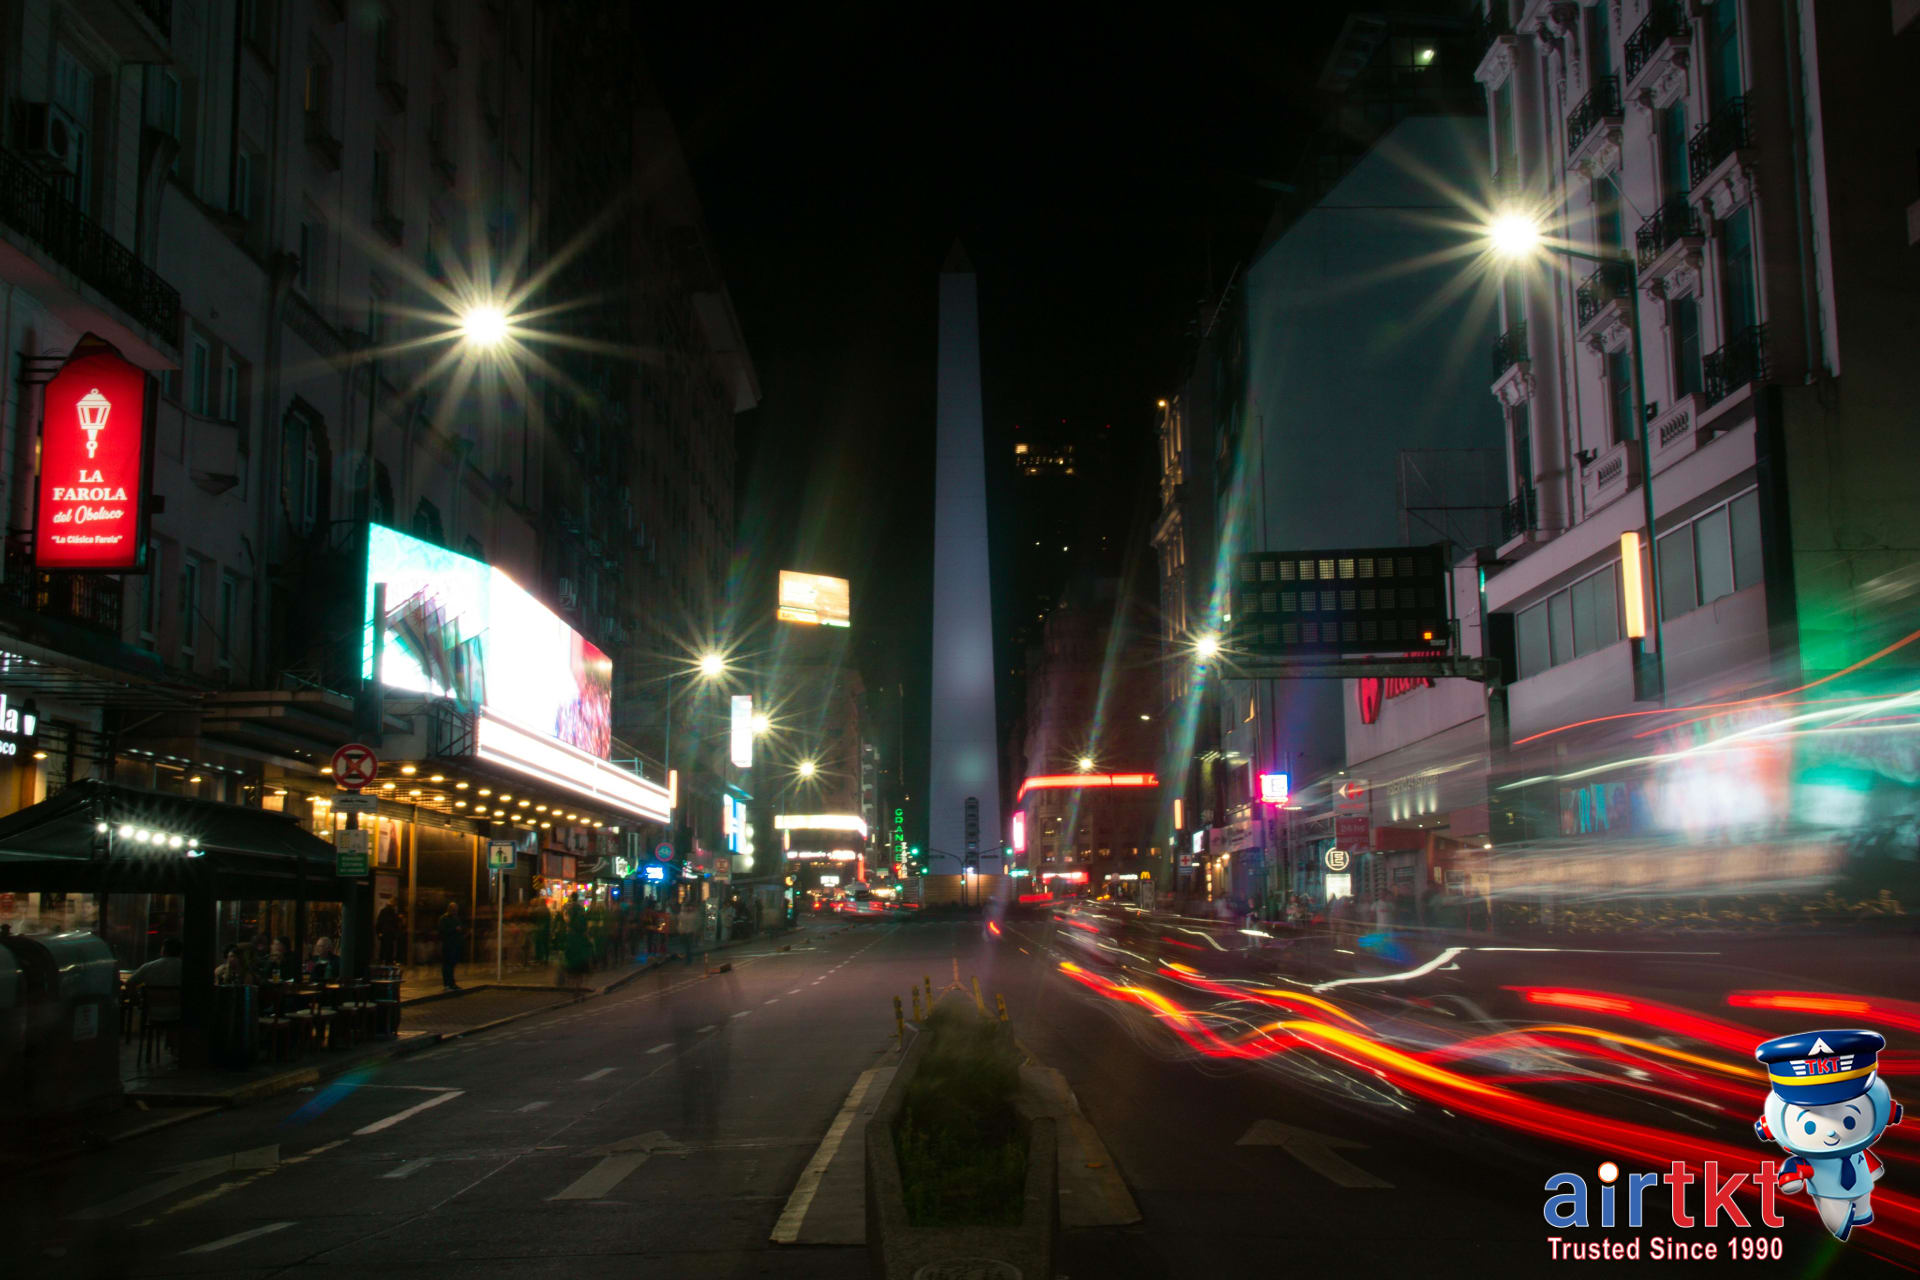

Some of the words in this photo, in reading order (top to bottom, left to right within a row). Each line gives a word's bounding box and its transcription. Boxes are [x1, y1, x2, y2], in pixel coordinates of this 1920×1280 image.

[79, 469, 104, 483] LA
[52, 487, 128, 501] FAROLA
[53, 508, 73, 523] del
[75, 505, 125, 525] Obelisco
